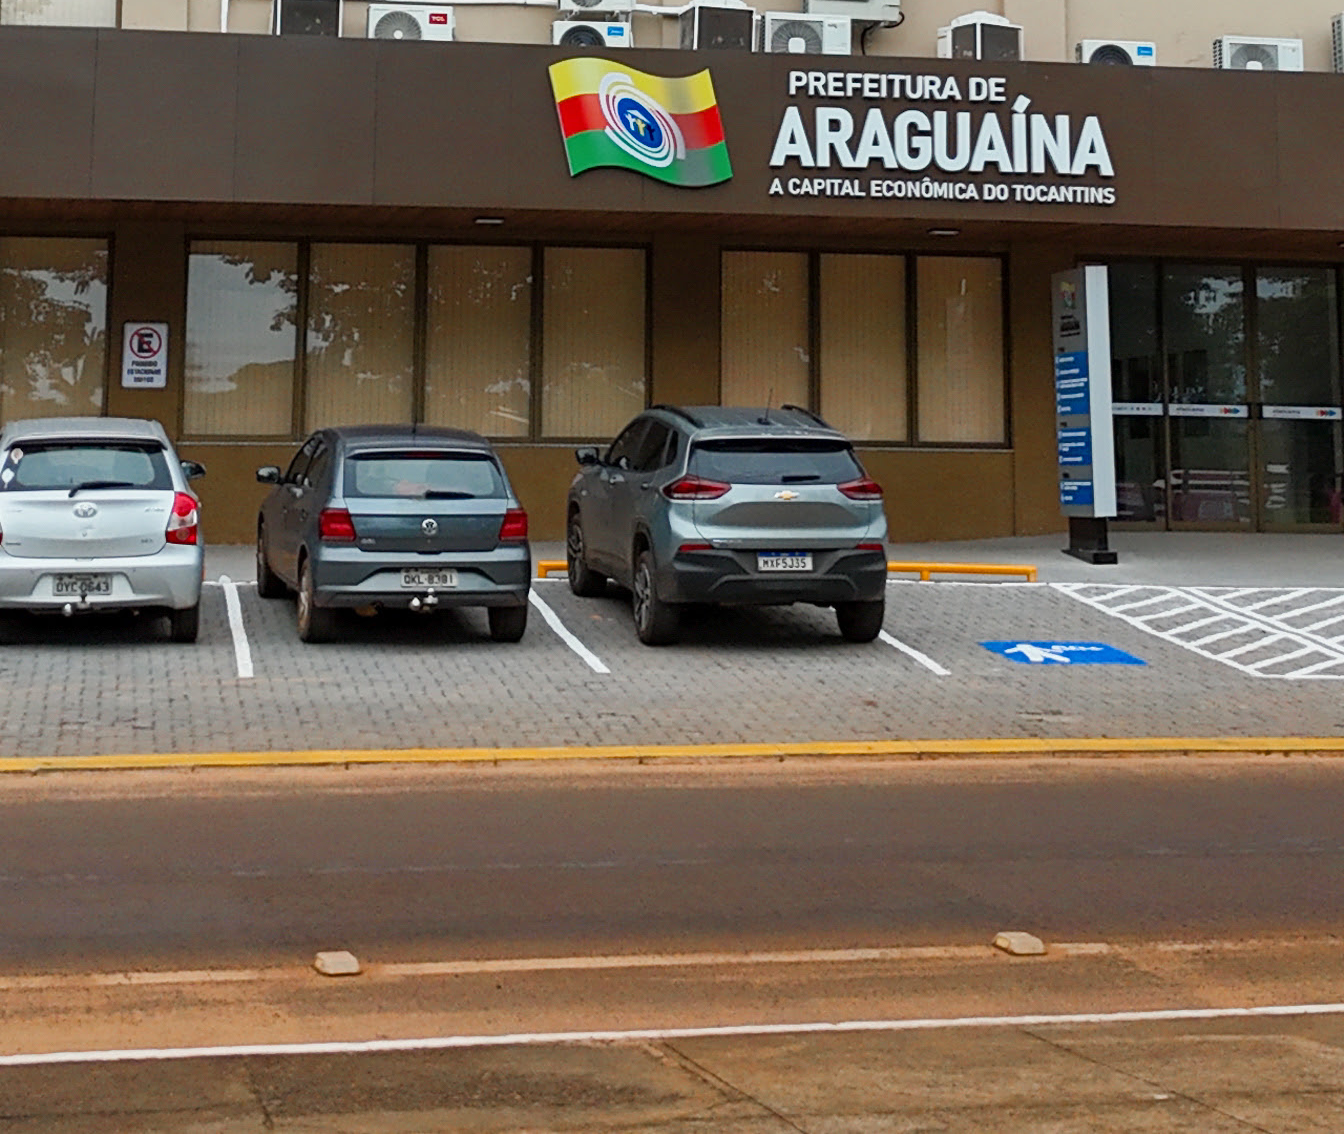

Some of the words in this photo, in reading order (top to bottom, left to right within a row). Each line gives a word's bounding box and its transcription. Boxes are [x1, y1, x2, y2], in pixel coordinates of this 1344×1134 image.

[788, 70, 963, 102] PREFEITURA
[968, 76, 1007, 103] DE
[768, 94, 1116, 177] ARAGUAÍNA
[768, 177, 784, 196] A
[787, 177, 867, 198] CAPITAL
[869, 176, 980, 201] ECONÔMICA
[982, 183, 1010, 202] DO
[1011, 184, 1117, 205] TOCANTINS
